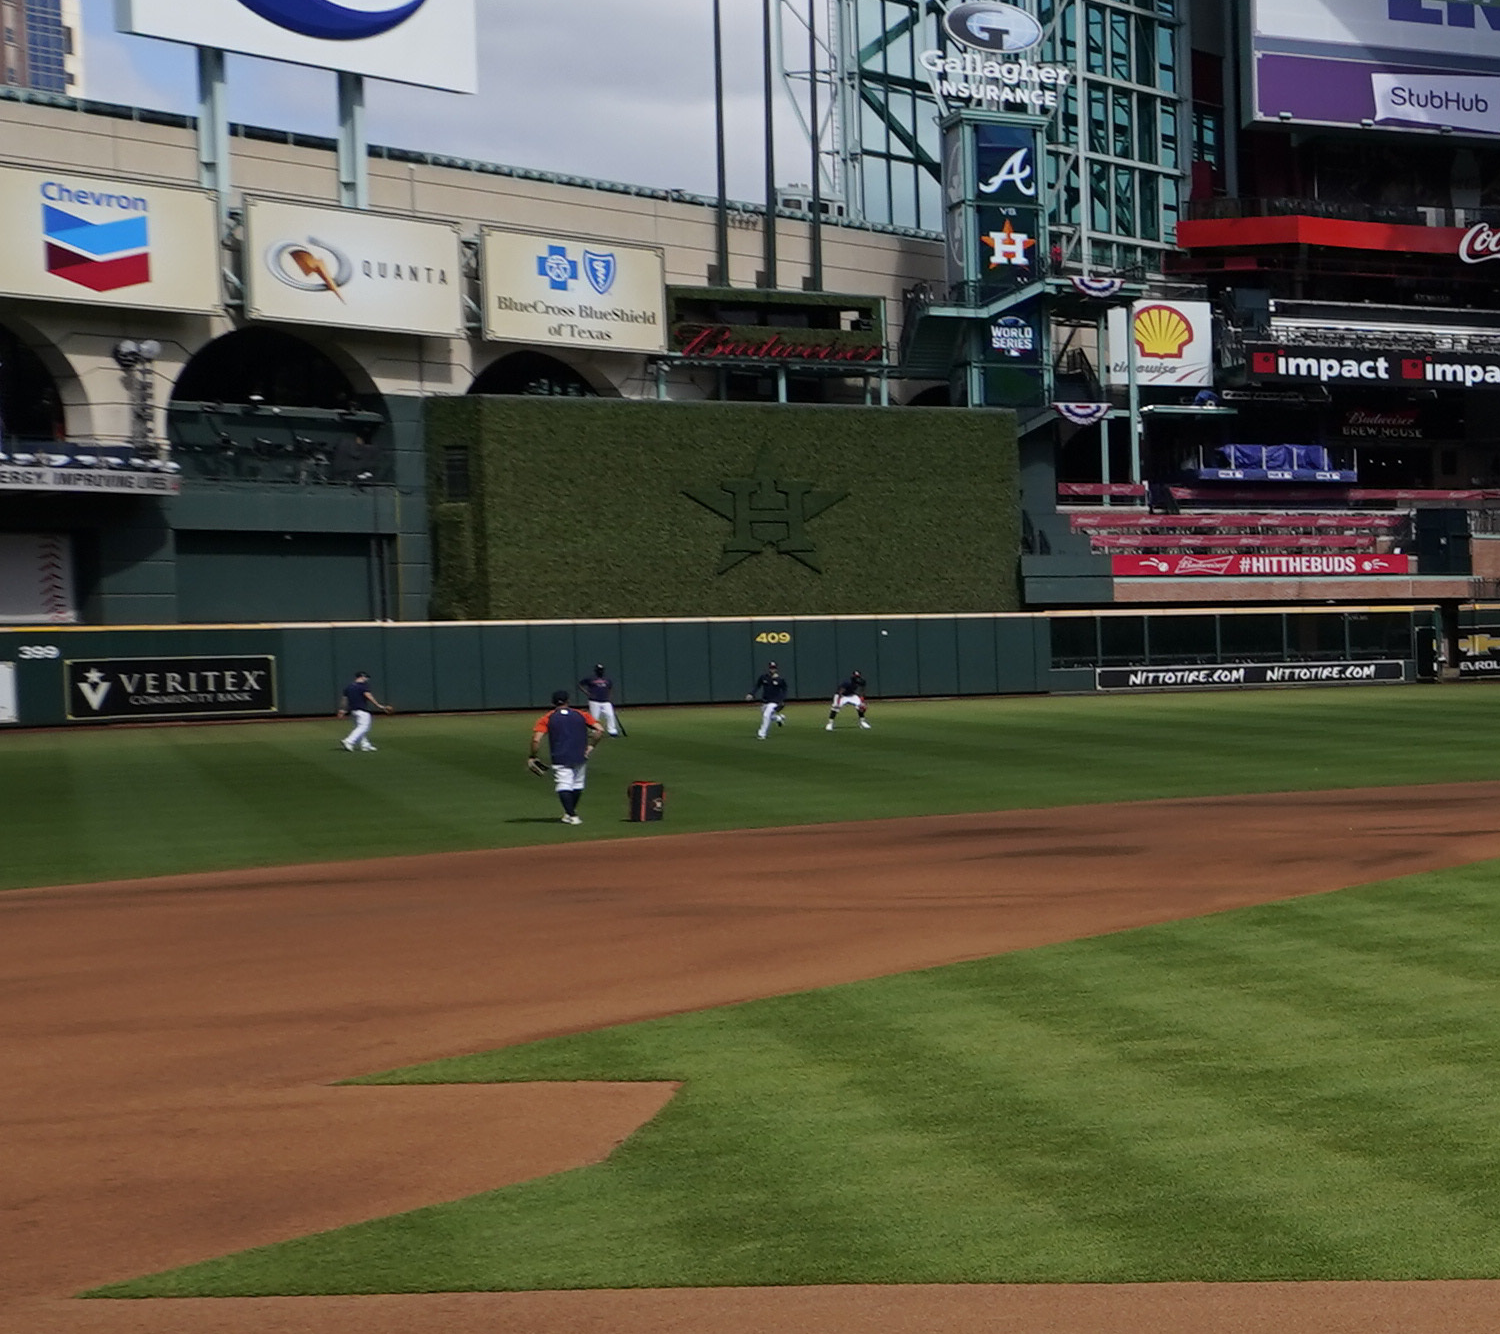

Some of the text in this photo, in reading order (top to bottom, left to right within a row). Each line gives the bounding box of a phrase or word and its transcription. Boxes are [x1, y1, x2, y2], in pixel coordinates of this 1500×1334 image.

[919, 49, 1073, 86] Gallagher
[936, 79, 1058, 107] INSURANCE
[1390, 86, 1489, 114] StubHub
[40, 180, 149, 212] Chevron
[1000, 207, 1017, 216] VS
[362, 259, 450, 286] QUANTA
[497, 295, 657, 325] BlueCross BlueShield
[548, 324, 612, 342] of Texas
[991, 325, 1033, 339] WORLD
[673, 324, 884, 363] Budweiser
[992, 337, 1033, 351] SERIES
[1277, 348, 1390, 382] impact
[1344, 409, 1416, 425] Budweiser
[1343, 425, 1423, 438] BREW HOUSE
[1239, 555, 1357, 574] #HITTHEBUDS
[755, 631, 791, 644] 409
[18, 645, 60, 659] 399
[118, 670, 262, 694] VERITEX
[1128, 668, 1245, 686] NITTOTIRE.COM
[1265, 664, 1376, 682] NITTOTIRE.COM
[128, 691, 253, 706] COMMUNITY BANK
